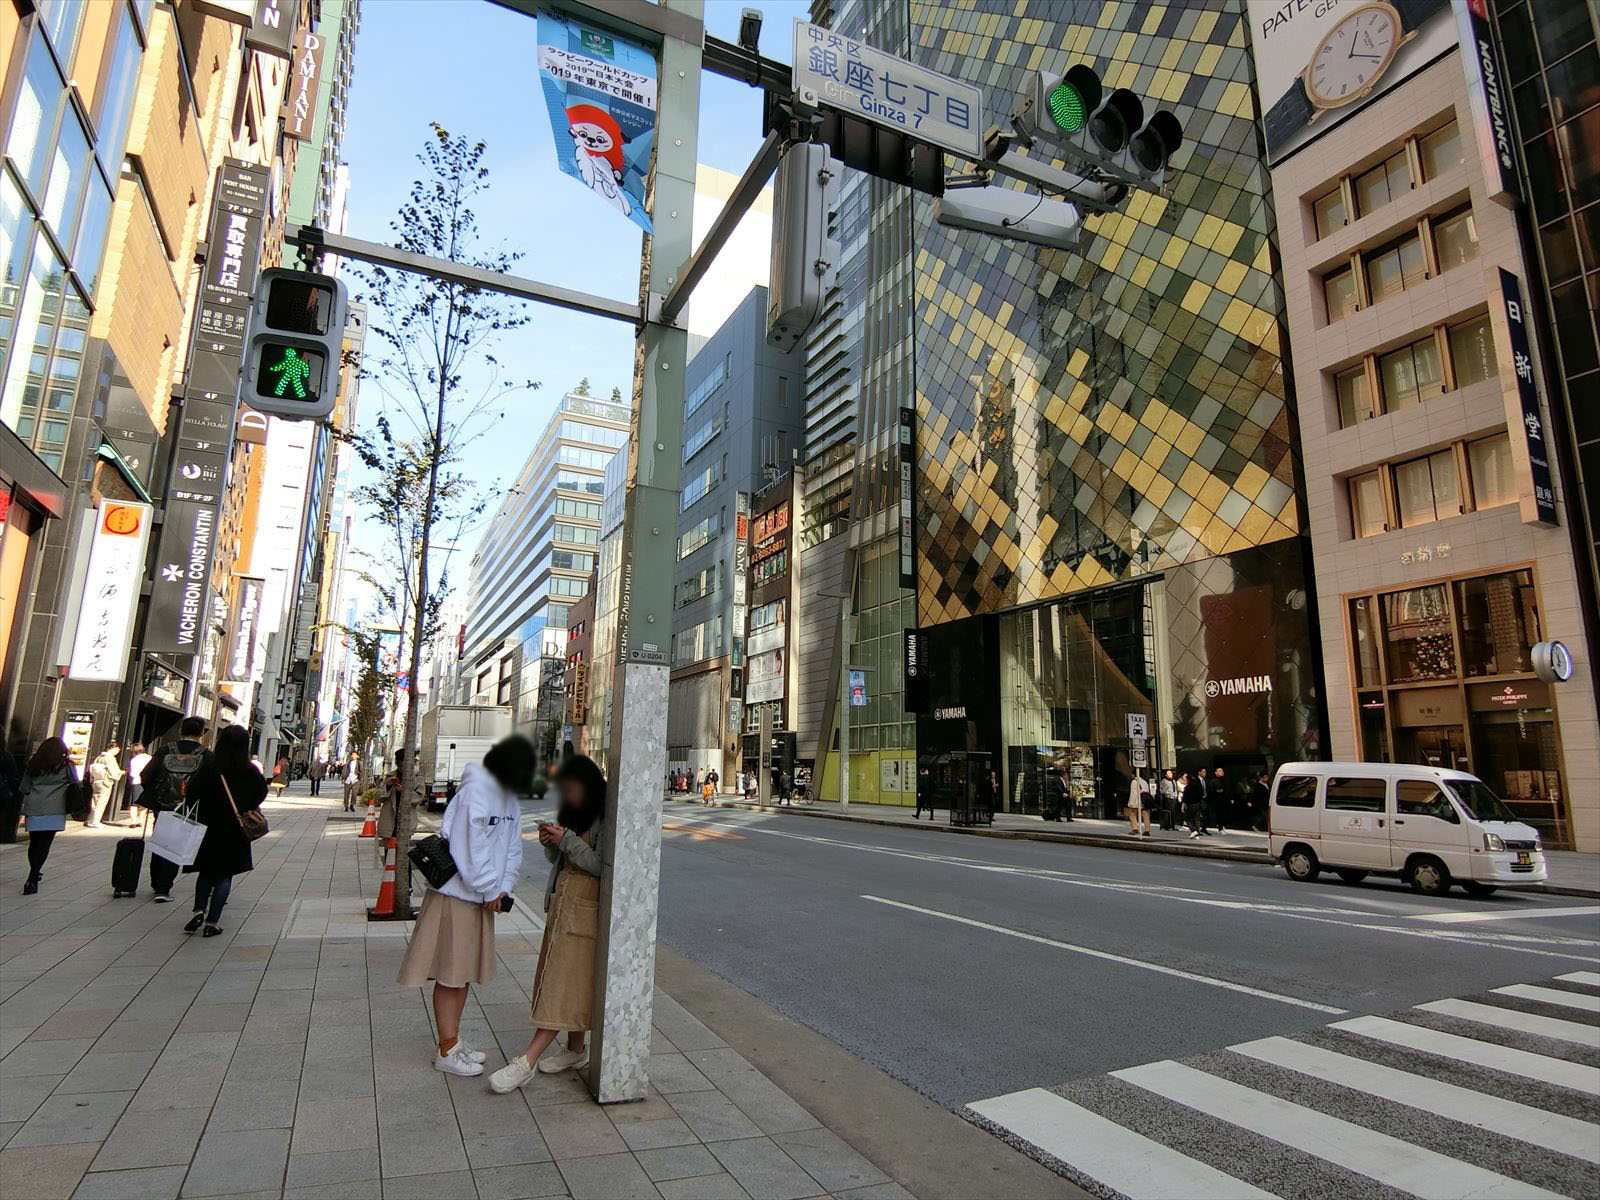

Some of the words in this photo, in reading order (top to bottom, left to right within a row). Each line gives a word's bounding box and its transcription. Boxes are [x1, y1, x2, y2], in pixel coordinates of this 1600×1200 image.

[1261, 0, 1312, 39] PATE
[808, 26, 862, 60] 中央区
[547, 46, 649, 84] ラグビーワールドカップ
[294, 34, 320, 133] DAMIANI
[807, 45, 970, 130] 銀座七丁目
[1478, 39, 1510, 159] MONTBLANC
[859, 94, 906, 125] Ginza
[913, 113, 924, 129] 7
[219, 214, 248, 289] 買取専門店
[1506, 300, 1541, 441] 日新堂
[204, 392, 219, 400] 4F
[196, 441, 211, 450] 3F
[188, 509, 214, 579] CONSTANTIN
[736, 546, 746, 573] ダンス
[178, 583, 202, 645] VACHERON
[908, 634, 917, 666] YAMAHA
[1220, 675, 1273, 696] YAMAHA
[941, 706, 967, 720] YAMAHA
[1130, 715, 1145, 723] TAXI
